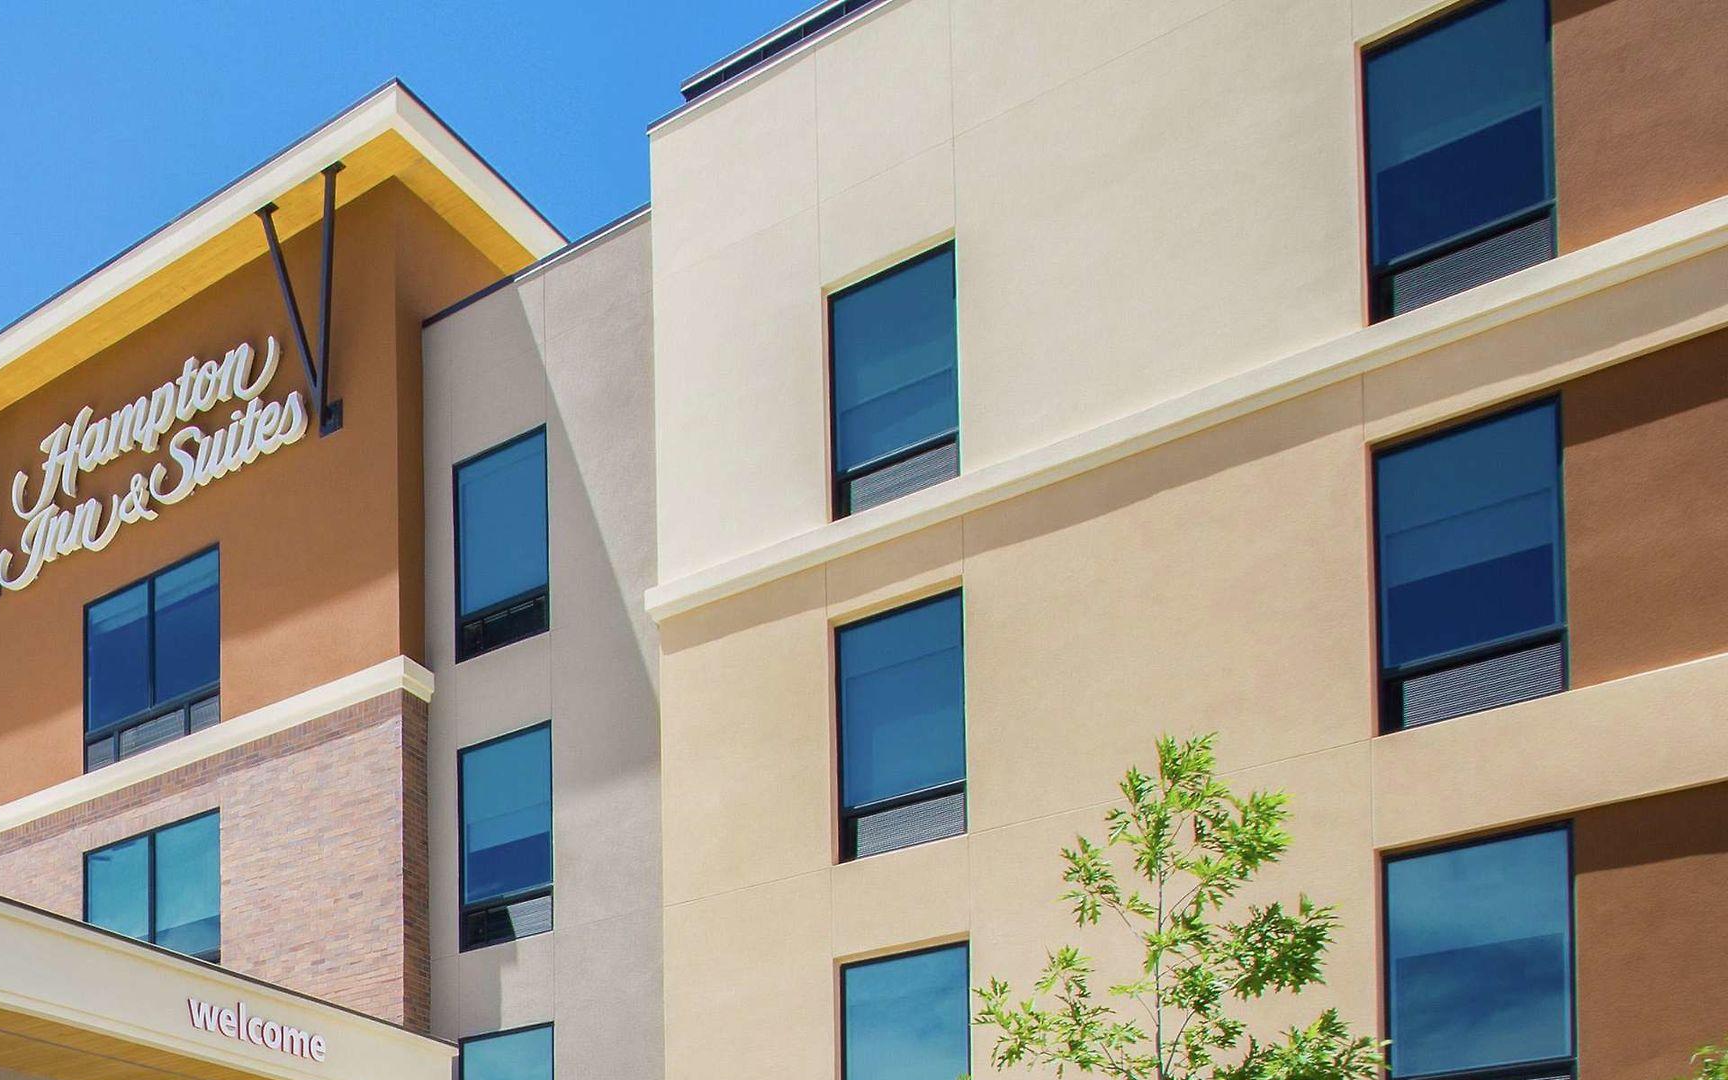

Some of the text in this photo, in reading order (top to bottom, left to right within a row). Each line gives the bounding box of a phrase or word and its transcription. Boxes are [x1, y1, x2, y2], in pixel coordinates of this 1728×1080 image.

[12, 336, 279, 521] Hampton
[119, 473, 158, 524] &
[150, 391, 308, 505] Suites
[188, 998, 326, 1062] welcome
